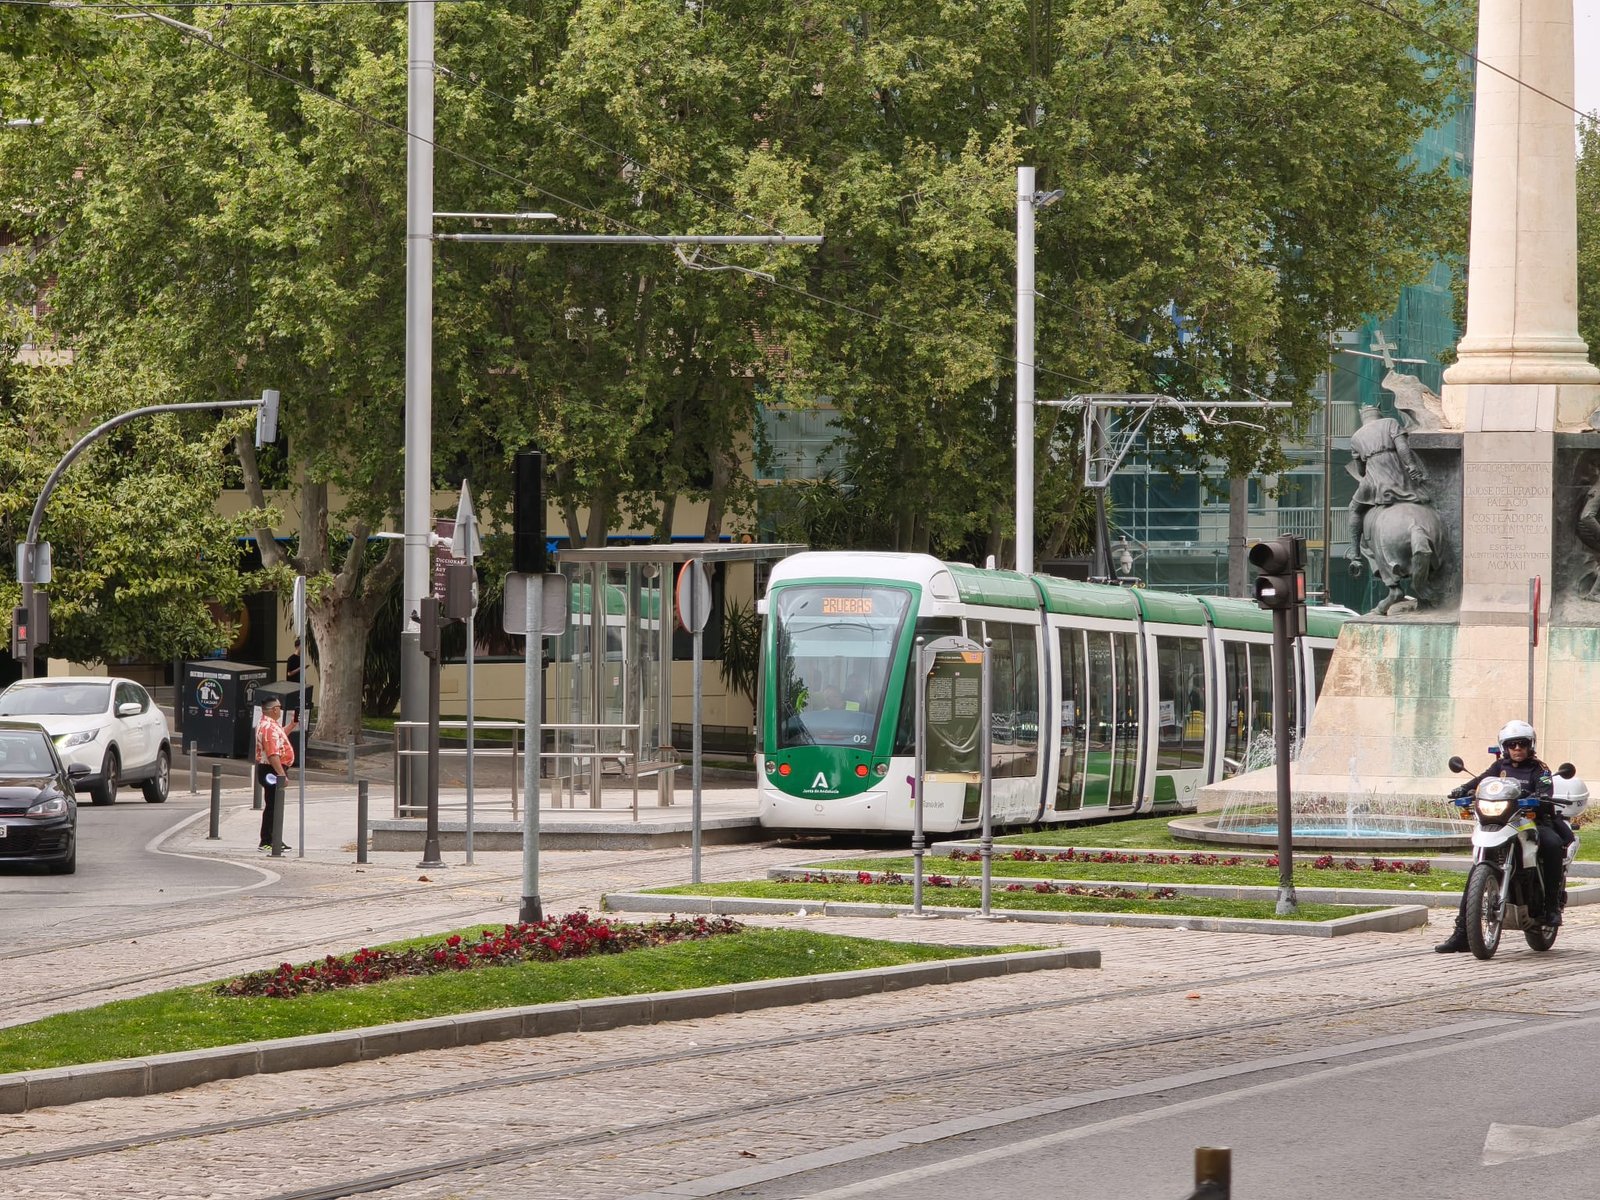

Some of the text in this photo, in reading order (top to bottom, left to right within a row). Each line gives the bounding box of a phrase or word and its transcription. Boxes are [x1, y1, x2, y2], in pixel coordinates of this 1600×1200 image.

[1487, 497, 1529, 507] PALACIO
[1472, 513, 1544, 523] COSTEADO POR
[1487, 560, 1526, 570] MCMXII
[823, 598, 872, 613] PRUEBAS
[853, 734, 867, 744] 02
